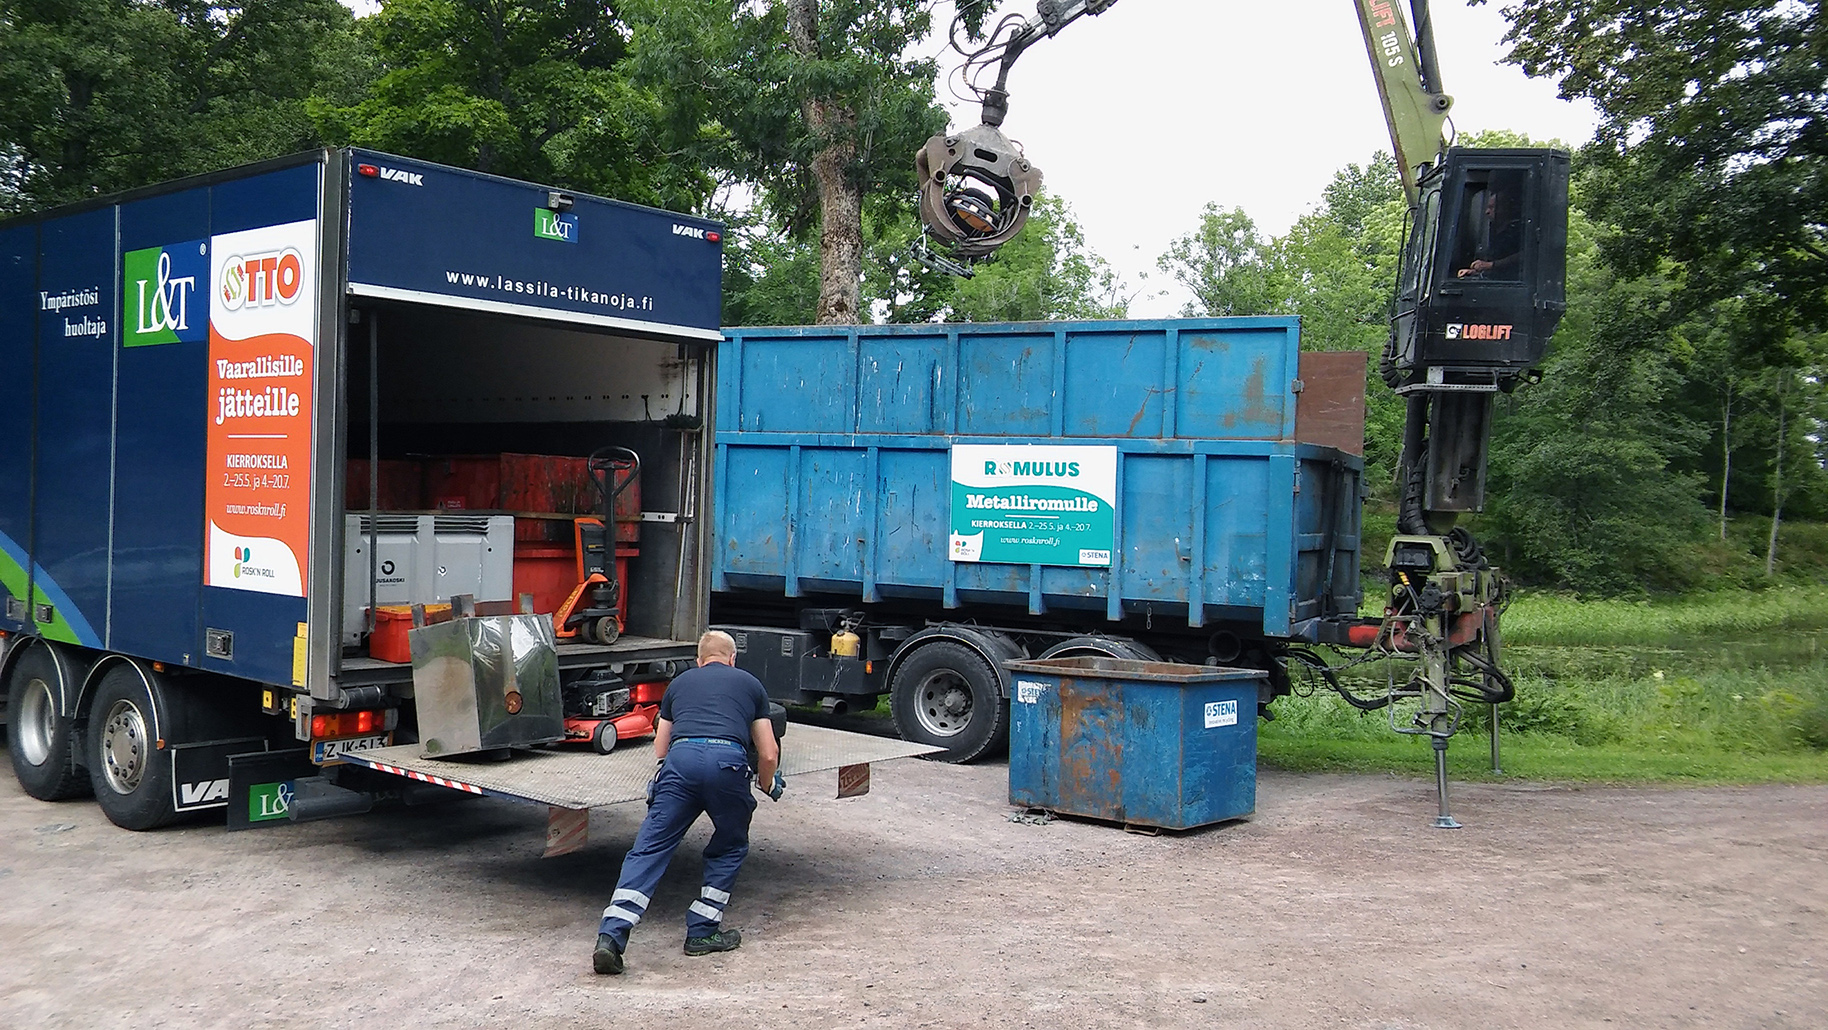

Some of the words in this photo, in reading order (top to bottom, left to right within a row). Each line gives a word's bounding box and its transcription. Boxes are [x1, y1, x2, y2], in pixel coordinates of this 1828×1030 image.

[380, 166, 424, 186] VAK
[541, 212, 574, 239] L&T
[672, 223, 705, 239] VAK
[40, 286, 99, 313] Ympäristösi
[136, 252, 195, 334] L&T
[446, 270, 653, 311] www.lassila-tikanoja.fi
[64, 315, 107, 339] huoltaja
[1462, 324, 1513, 340] LOGLIFT
[216, 355, 303, 379] Vaarallisille
[215, 386, 300, 425] jätteille
[226, 454, 288, 469] KIERROKSELLA
[252, 474, 260, 491] ja
[226, 502, 287, 519] www.rosknroll.fi
[965, 494, 1099, 513] Metalliromulle
[971, 520, 1027, 529] KIERROKSELLA
[1056, 522, 1064, 532] ja
[262, 568, 275, 578] ROLL
[1212, 702, 1236, 717] STENA
[181, 779, 230, 804] VA
[260, 783, 295, 817] L&
